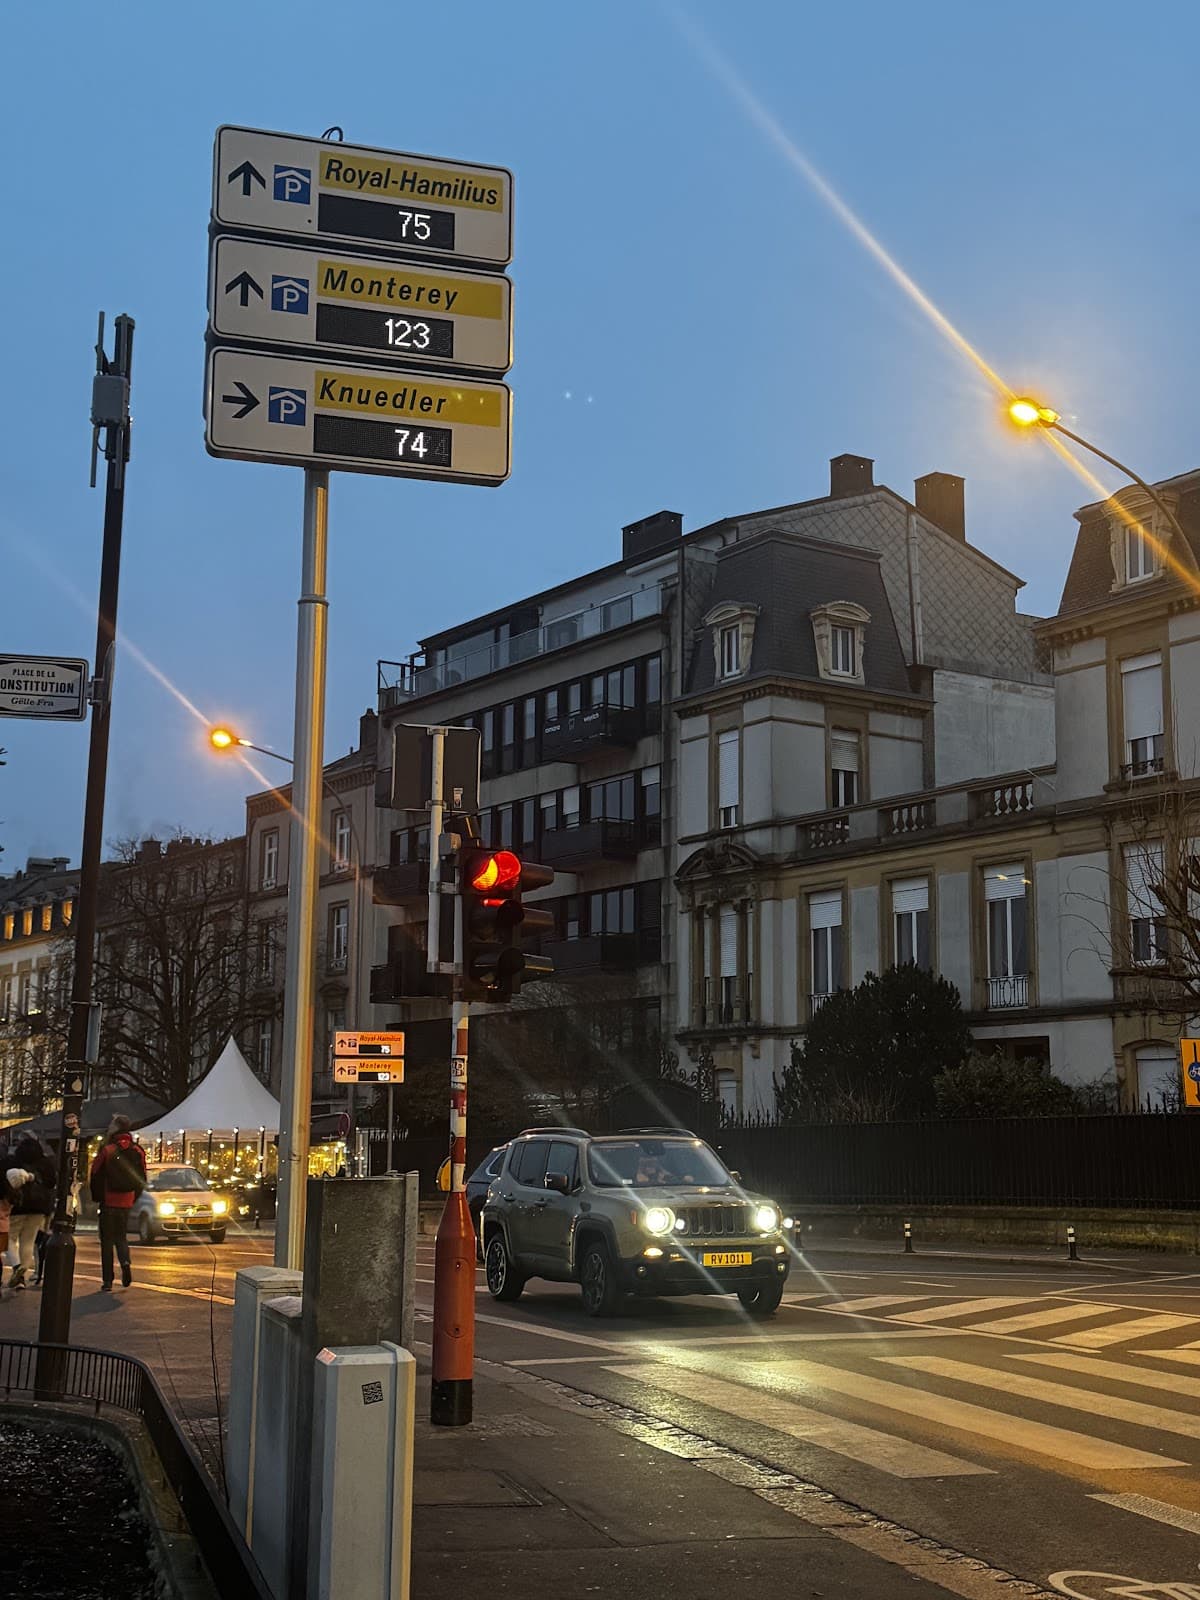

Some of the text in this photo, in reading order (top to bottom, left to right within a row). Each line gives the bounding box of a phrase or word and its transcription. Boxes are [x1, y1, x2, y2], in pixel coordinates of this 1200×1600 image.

[325, 159, 498, 205] Royal-Hamilius
[399, 211, 431, 240] 75
[323, 267, 458, 311] Monterey
[384, 318, 431, 349] 123
[319, 377, 447, 414] Knuedler
[395, 429, 428, 458] 74
[0, 678, 74, 694] ONSTITUTION
[12, 668, 34, 677] PLACE
[36, 699, 54, 707] Fra
